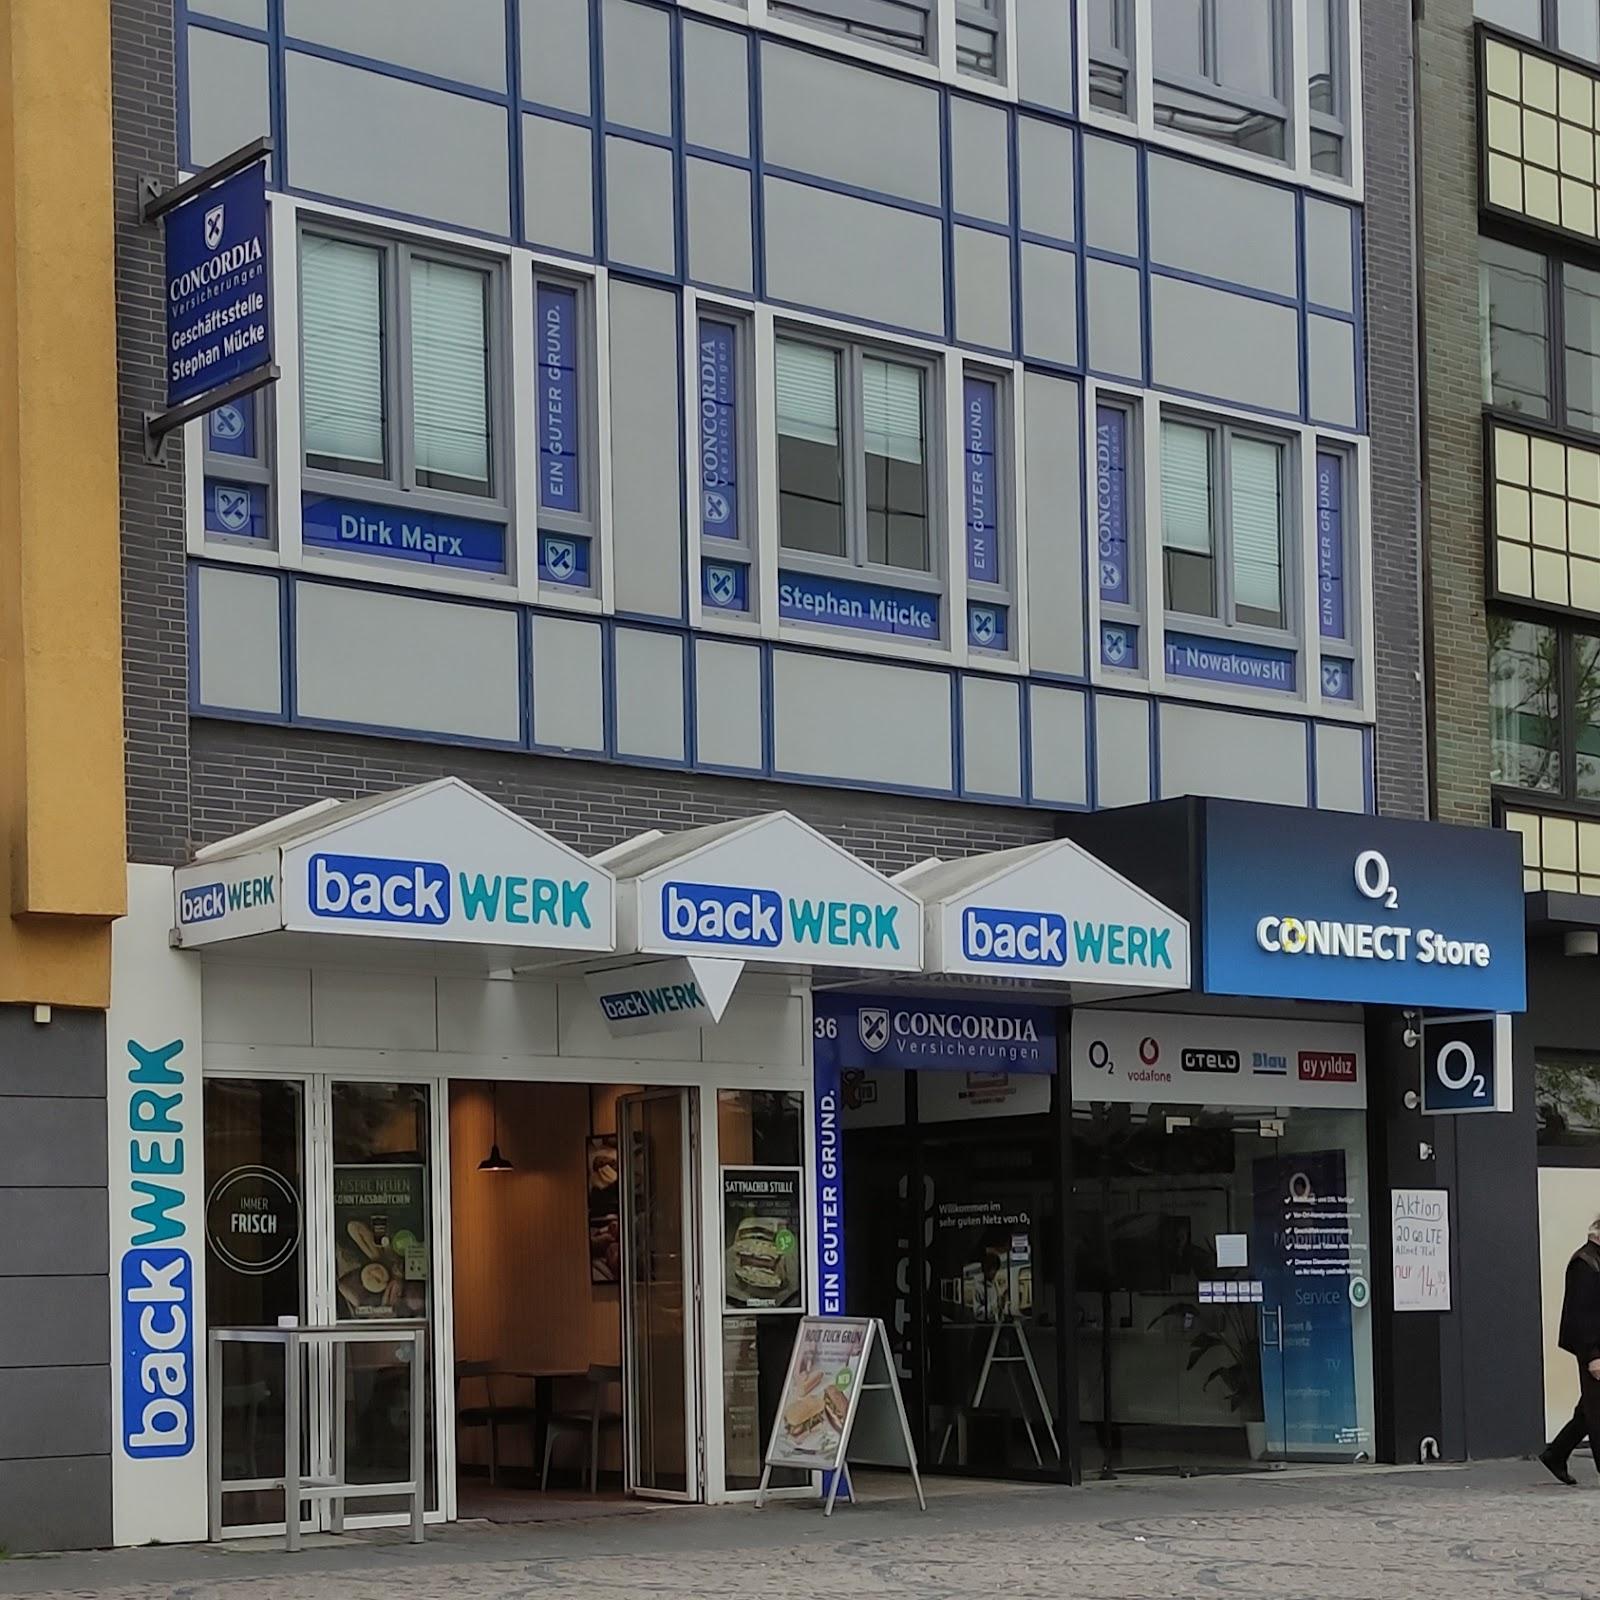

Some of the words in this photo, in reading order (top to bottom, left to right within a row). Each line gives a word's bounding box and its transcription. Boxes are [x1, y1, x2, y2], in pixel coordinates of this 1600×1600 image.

[170, 236, 262, 301] CONCORDIA
[172, 263, 263, 318] Versicherungen
[172, 293, 263, 351] Geschäftsstelle
[547, 305, 561, 380] GRUND.
[172, 346, 220, 381] Stephan
[224, 324, 265, 354] Mücke
[548, 388, 563, 455] GUTER
[701, 340, 718, 487] CONCORDIA
[971, 398, 983, 465] GRUND.
[550, 462, 564, 496] EIN
[1097, 424, 1111, 556] CONCORDIA
[972, 471, 984, 532] GUTER
[1320, 470, 1330, 532] GRUND.
[341, 514, 393, 545] Dirk
[401, 524, 463, 556] Marx
[974, 540, 985, 569] EIN
[1321, 537, 1332, 592] GUTER
[780, 585, 863, 617] Stephan
[869, 598, 931, 628] Mücke
[1323, 603, 1332, 625] EIN
[1166, 644, 1180, 666] T.
[1186, 649, 1285, 681] Nowakowski
[459, 872, 591, 929] WERK
[789, 897, 901, 951] WERK
[1073, 921, 1173, 969] WERK
[1256, 915, 1411, 960] CONNECT
[1416, 929, 1490, 967] Store
[814, 1018, 837, 1038] 36
[894, 1011, 1039, 1042] CONCORDIA
[896, 1039, 1039, 1061] Versicherungen
[1253, 1053, 1287, 1069] Blau
[1303, 1061, 1318, 1077] ay
[1128, 1069, 1172, 1082] vodafone
[127, 1038, 187, 1246] WERK
[821, 1090, 837, 1179] GRUND.
[241, 1197, 269, 1210] IMMER
[725, 1181, 769, 1193] SATTMACHER
[770, 1181, 793, 1193] STULLE
[990, 1201, 1000, 1211] im
[1394, 1194, 1441, 1216] Aktion
[231, 1213, 277, 1233] FRISCH
[823, 1187, 838, 1265] GUTER
[957, 1216, 980, 1229] guten
[982, 1215, 1002, 1224] Netz
[1396, 1225, 1410, 1242] 20
[1426, 1227, 1442, 1244] LTE
[1395, 1264, 1412, 1279] nur
[824, 1273, 839, 1313] EIN
[1295, 1289, 1341, 1304] Service
